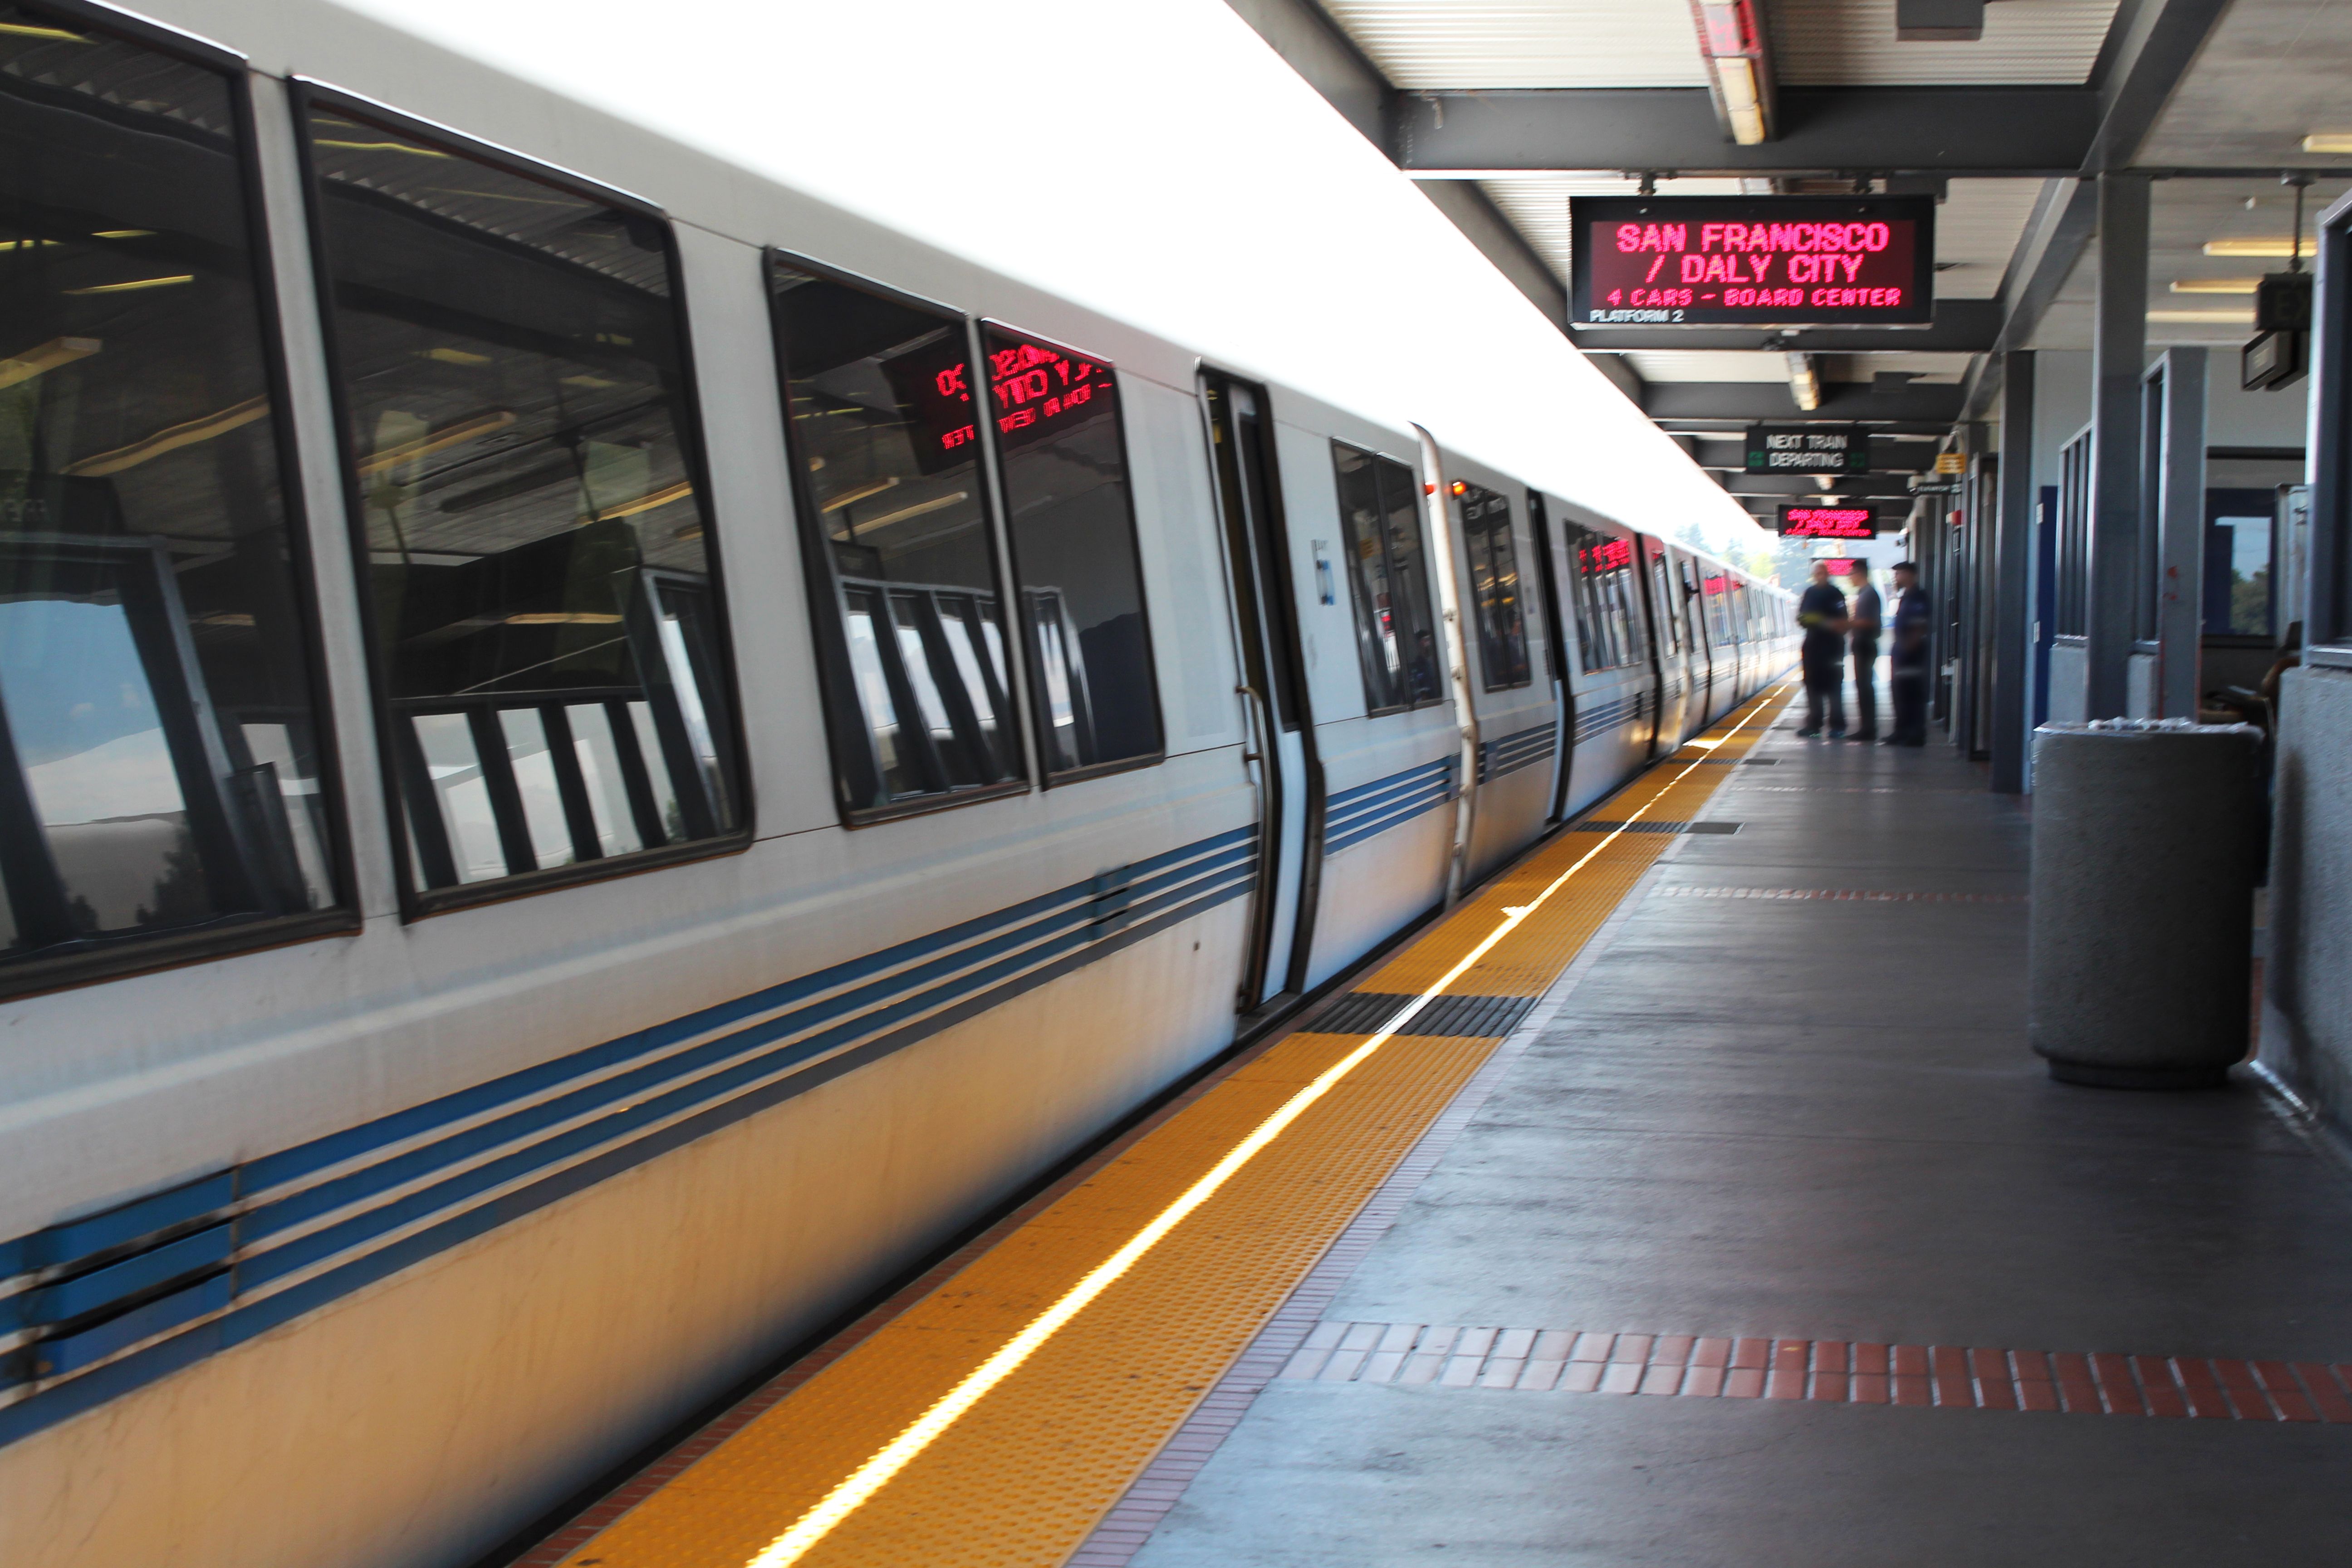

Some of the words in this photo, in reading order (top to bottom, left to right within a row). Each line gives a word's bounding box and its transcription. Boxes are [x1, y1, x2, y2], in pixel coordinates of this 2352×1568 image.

[1616, 223, 1687, 253] SAN
[1701, 222, 1890, 252] FRANCISCO
[1645, 254, 1666, 283] /
[1681, 254, 1772, 283] DALY
[1788, 254, 1864, 283] CITY
[1607, 288, 1622, 307] 4
[1630, 288, 1693, 307] CARS
[1724, 288, 1805, 307] BOARD
[1811, 288, 1901, 307] CENTER
[1589, 309, 1670, 323] PLATFORM
[1671, 309, 1685, 323] 2
[1766, 434, 1805, 449] NEXT
[1806, 434, 1848, 449] TRAIN
[1769, 452, 1844, 467] DEPARTING
